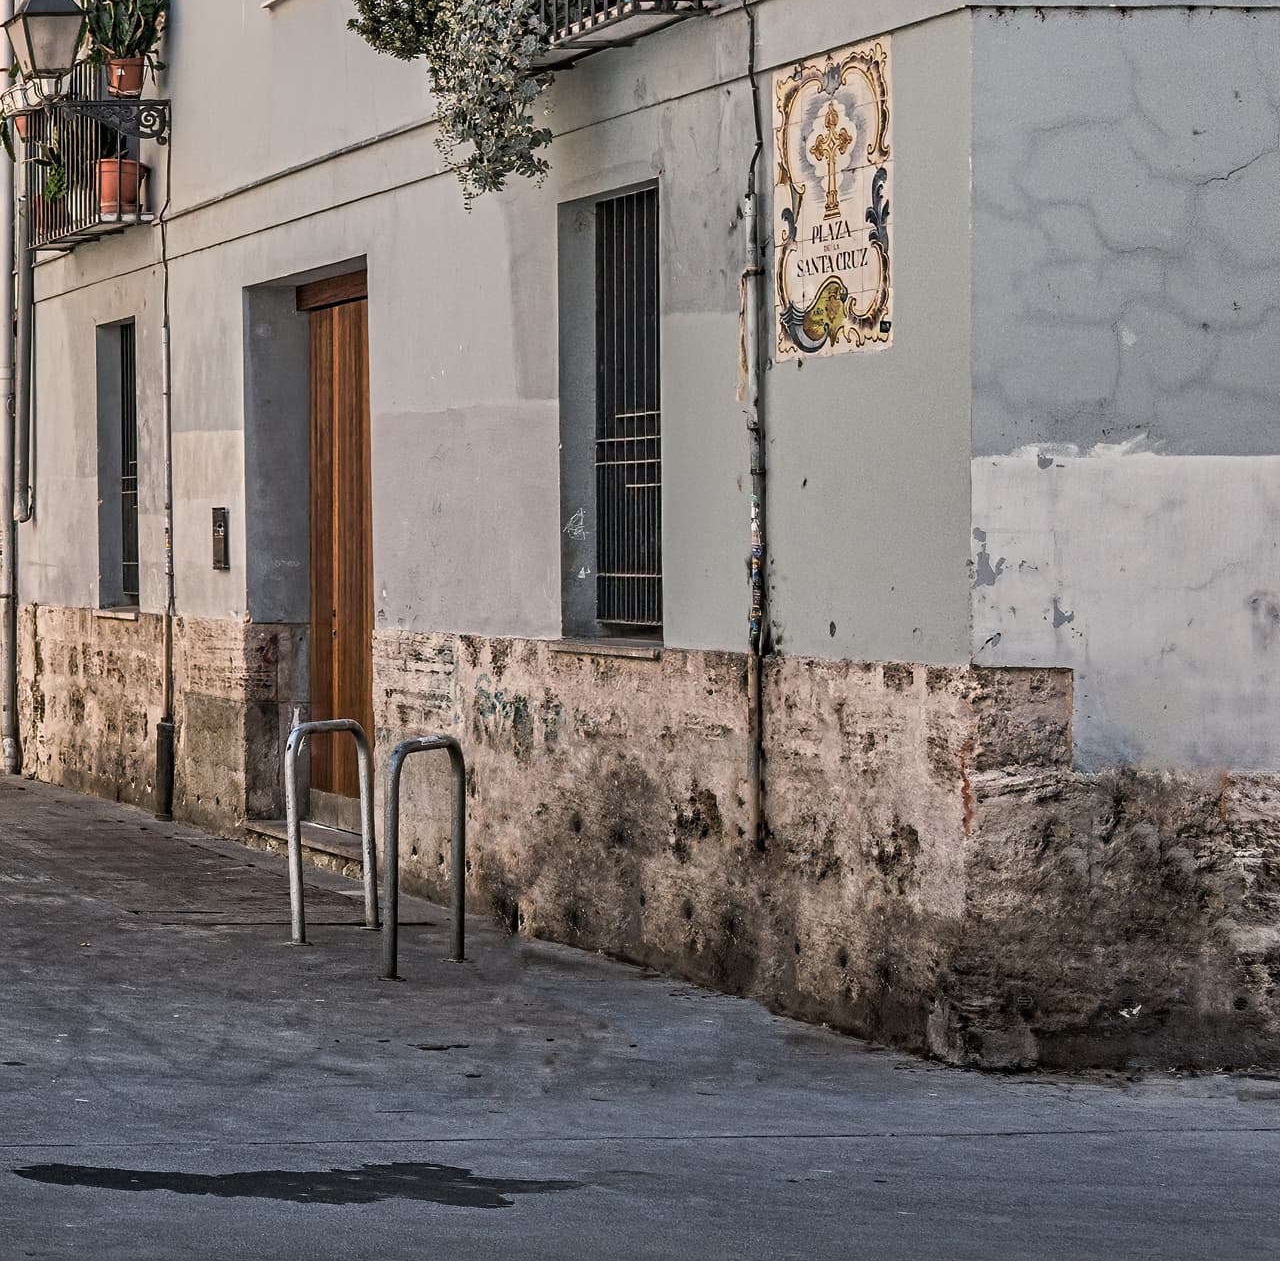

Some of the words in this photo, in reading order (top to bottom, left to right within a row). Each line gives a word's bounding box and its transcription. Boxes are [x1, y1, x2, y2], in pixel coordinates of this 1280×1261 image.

[811, 220, 852, 244] PLAZA
[797, 254, 835, 278] SANTA
[836, 247, 869, 271] CRUZ
